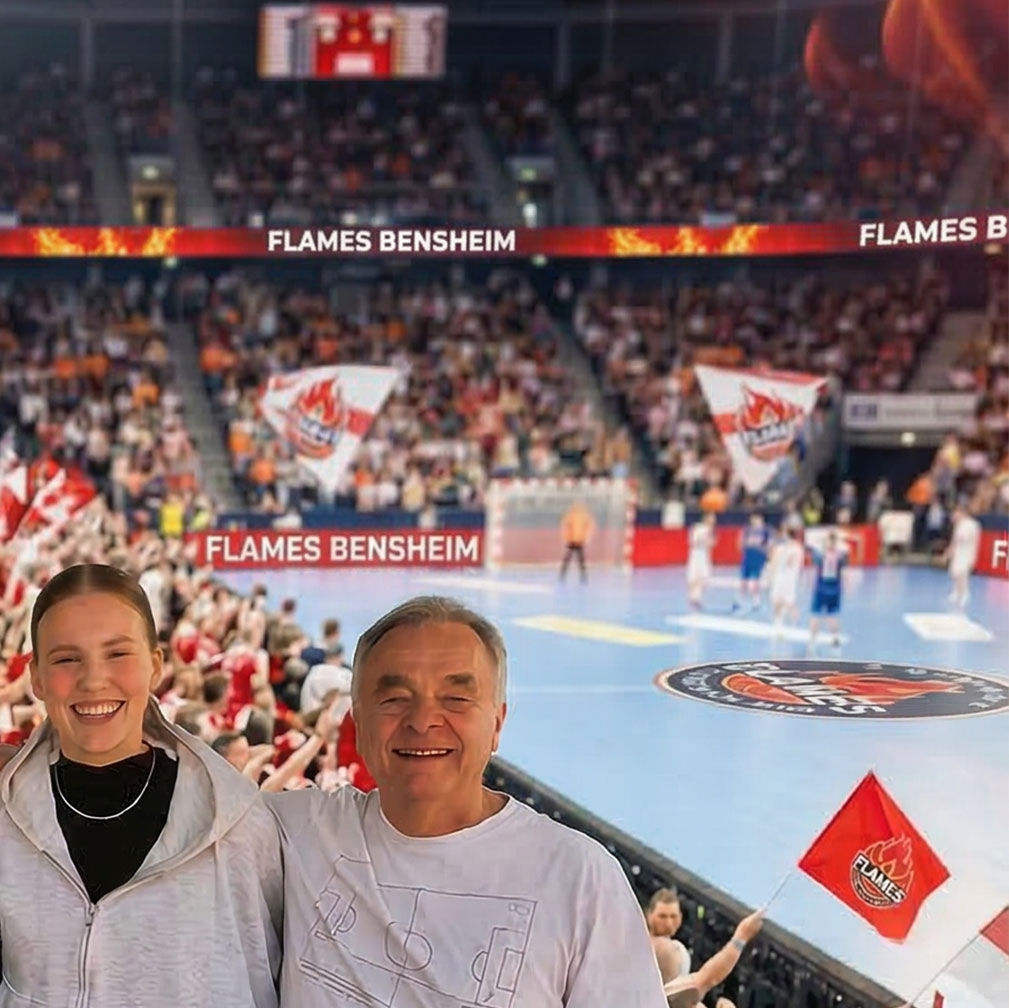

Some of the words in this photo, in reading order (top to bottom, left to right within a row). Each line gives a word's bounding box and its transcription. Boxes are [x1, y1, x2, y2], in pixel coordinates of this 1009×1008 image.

[267, 230, 372, 252] FLAMES
[379, 230, 516, 252] BENSHEIM
[859, 217, 977, 247] FLAMES
[206, 536, 321, 562] FLAMES
[330, 536, 479, 562] BENSHEIM
[852, 854, 906, 903] FLAMES
